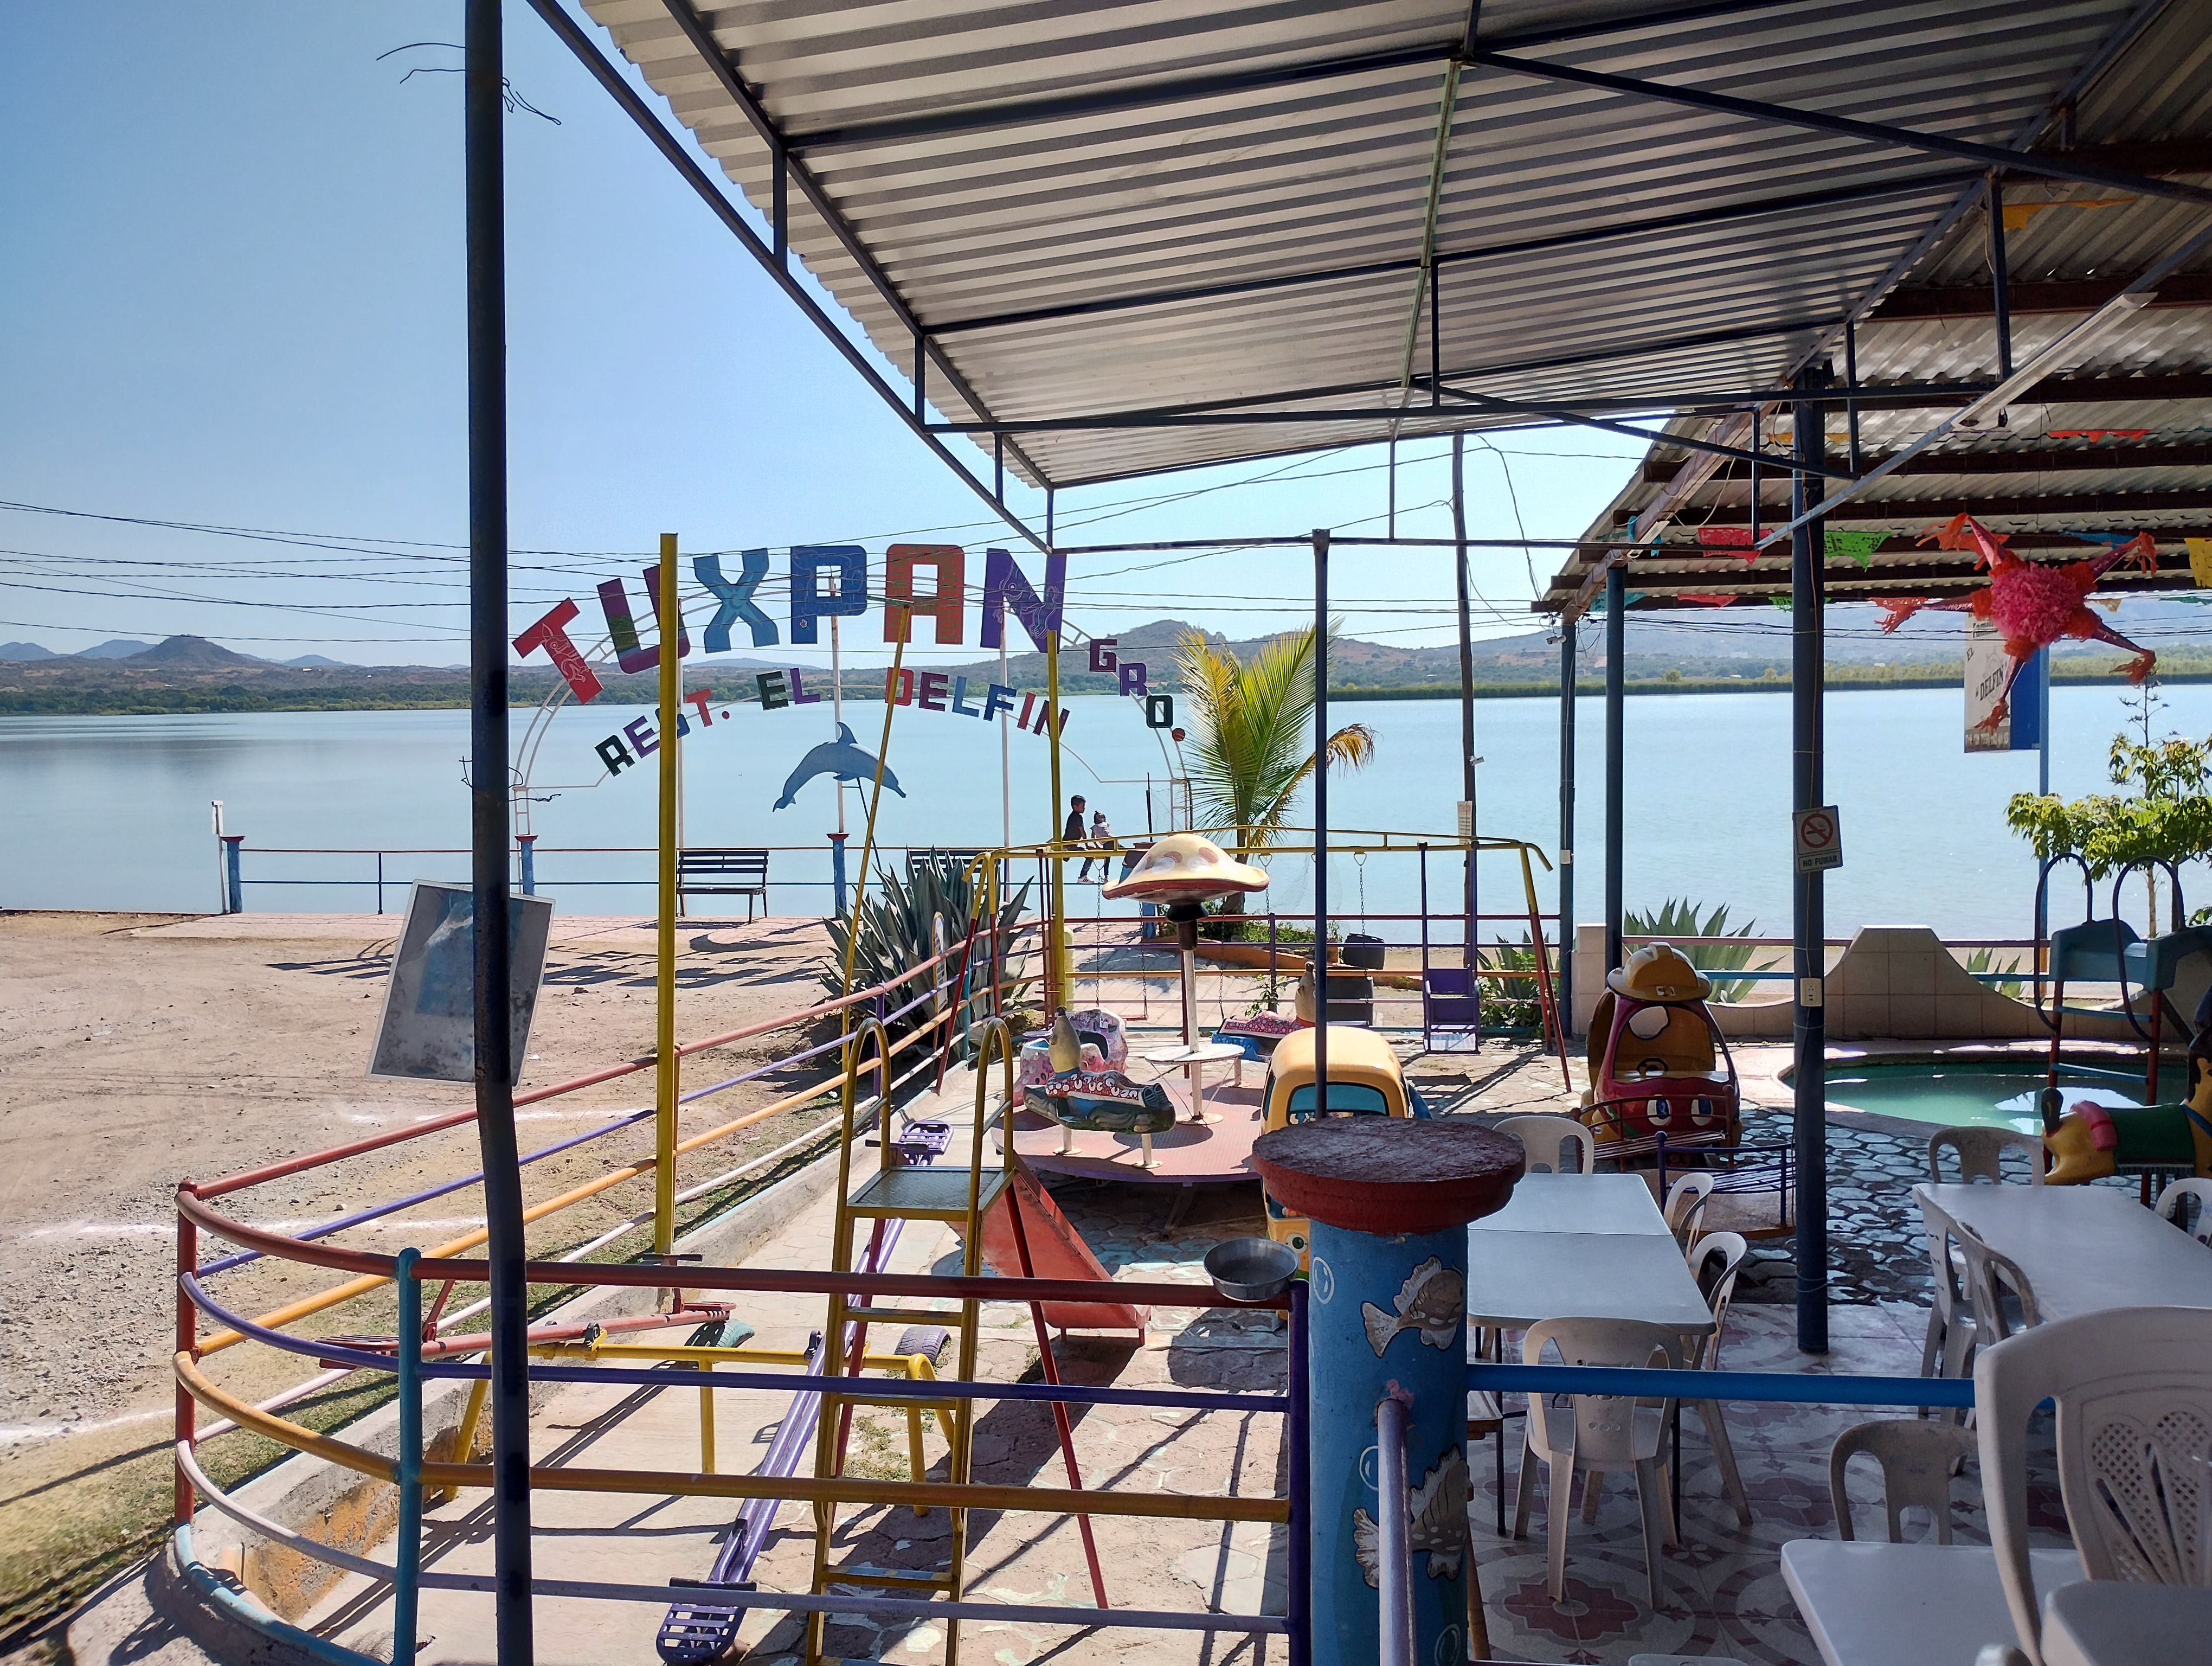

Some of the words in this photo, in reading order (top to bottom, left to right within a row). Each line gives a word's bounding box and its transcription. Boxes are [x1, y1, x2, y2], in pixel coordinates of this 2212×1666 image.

[512, 543, 1067, 705] TUXPAN
[756, 668, 821, 710] EL
[885, 667, 1070, 741] DELFIN
[1803, 859, 1812, 867] NO
[1815, 855, 1837, 866] FUMAR
